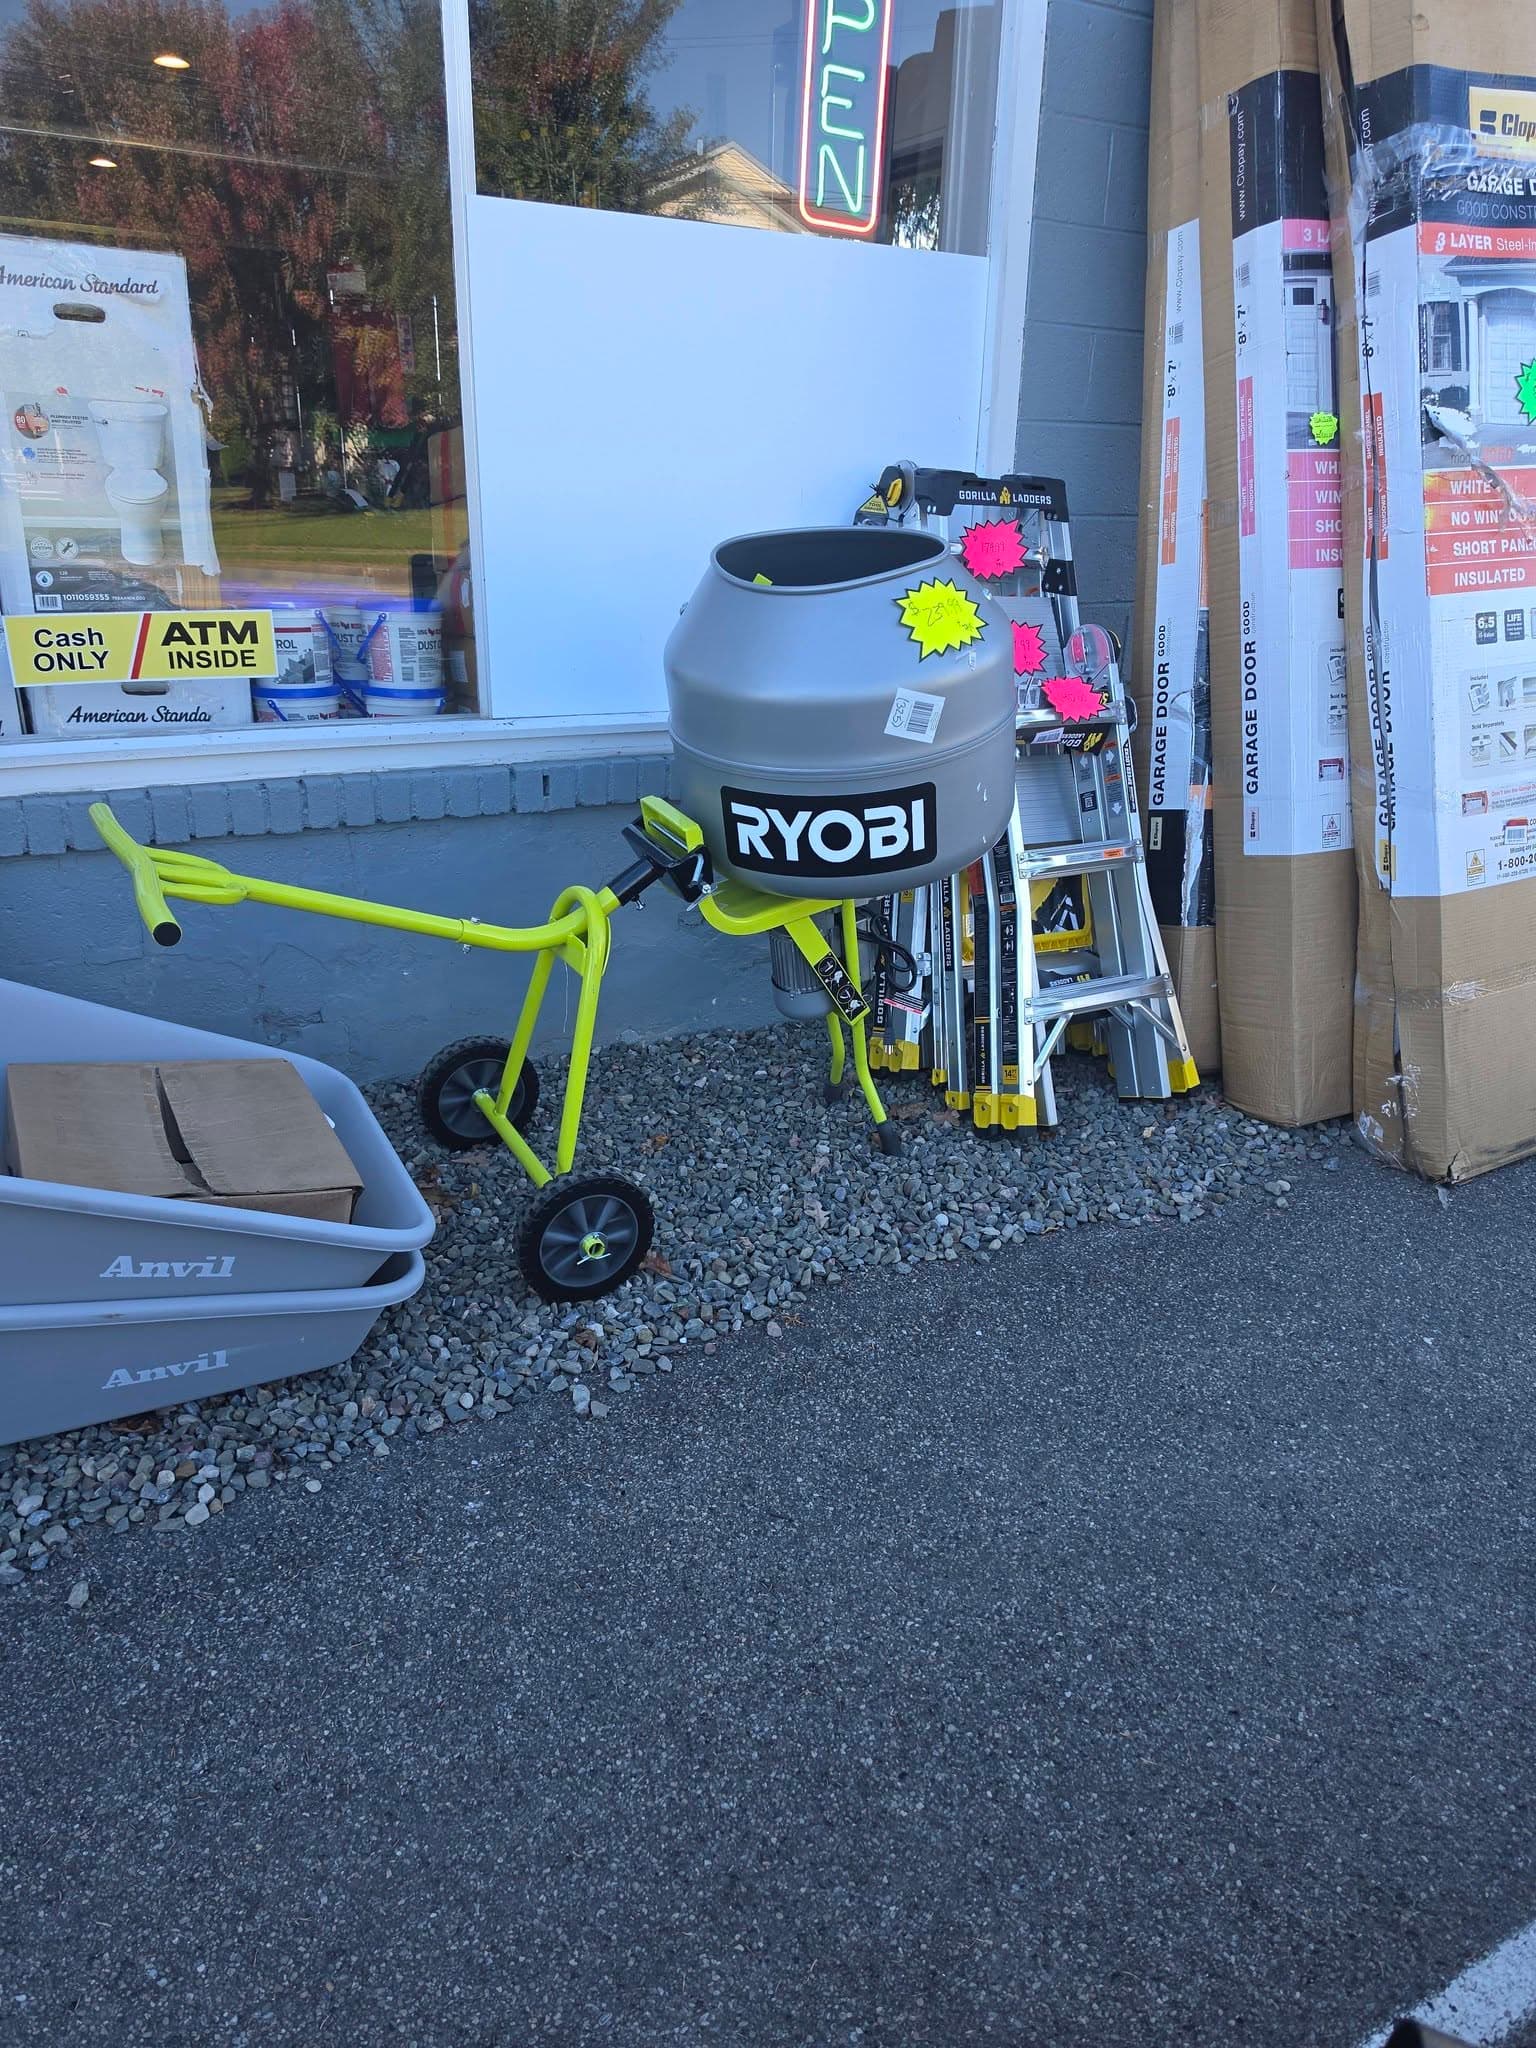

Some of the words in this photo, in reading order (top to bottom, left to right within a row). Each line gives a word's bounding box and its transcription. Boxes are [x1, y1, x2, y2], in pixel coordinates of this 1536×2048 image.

[1236, 111, 1245, 220] www.Clopay.com
[1466, 171, 1525, 197] GARAGE
[1456, 200, 1489, 218] GOOD
[1303, 227, 1313, 242] 3
[1450, 232, 1493, 250] LAYER
[80, 273, 159, 295] Standard
[1176, 231, 1184, 314] www.Clopay.com
[1375, 415, 1385, 456] INSULATED
[959, 490, 997, 502] GORILLA
[1012, 494, 1052, 506] LADDERS
[1450, 480, 1493, 495] WHITE
[1451, 511, 1470, 526] NO
[1453, 540, 1497, 556] SHORT
[1454, 567, 1526, 587] INSULATED
[1242, 601, 1250, 635] GOOD
[33, 628, 104, 648] Cash
[161, 620, 259, 646] ATM
[275, 639, 298, 650] ROL
[1157, 624, 1166, 657] GOOD
[1382, 619, 1390, 664] construction
[33, 650, 109, 672] ONLY
[168, 650, 257, 669] INSIDE
[1244, 640, 1257, 702] DOOR
[1156, 662, 1170, 719] DOOR
[66, 706, 148, 723] American
[1246, 708, 1259, 795] GARAGE
[1152, 725, 1167, 806] GARAGE
[730, 799, 926, 863] RYOBI
[944, 921, 952, 967] LADDERS
[876, 970, 886, 1024] GORILLA
[100, 1255, 236, 1278] Anvil
[102, 1349, 230, 1390] Anvil
